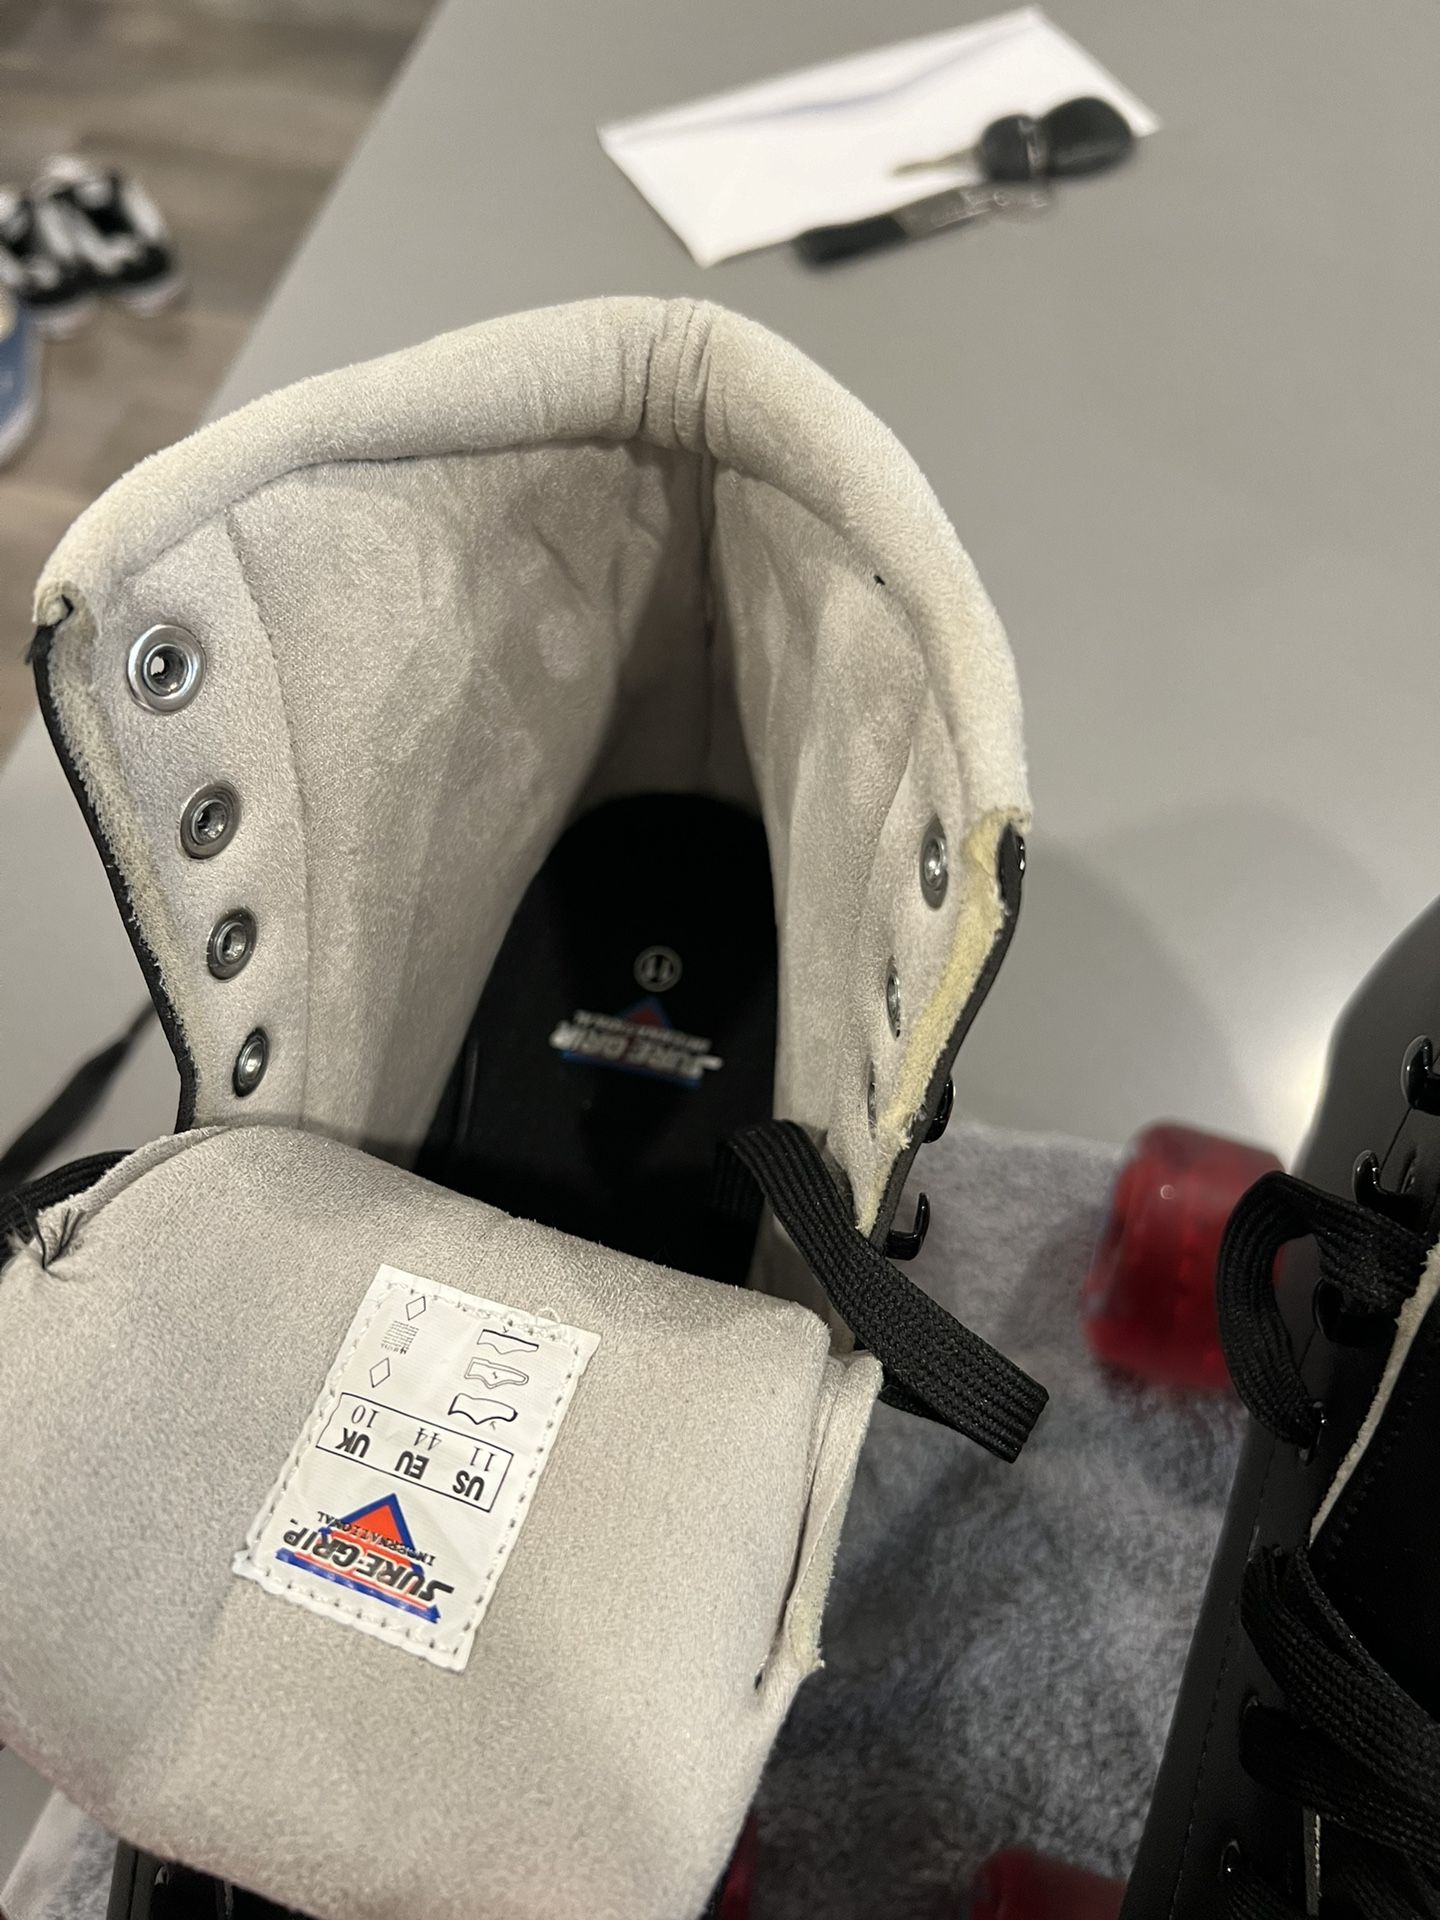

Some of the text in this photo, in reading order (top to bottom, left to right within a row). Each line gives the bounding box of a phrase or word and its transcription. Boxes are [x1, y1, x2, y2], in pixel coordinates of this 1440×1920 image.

[335, 1427, 485, 1501] US EU UK
[351, 1404, 497, 1472] 11 44 10
[317, 1511, 437, 1567] INTERNATIONAL
